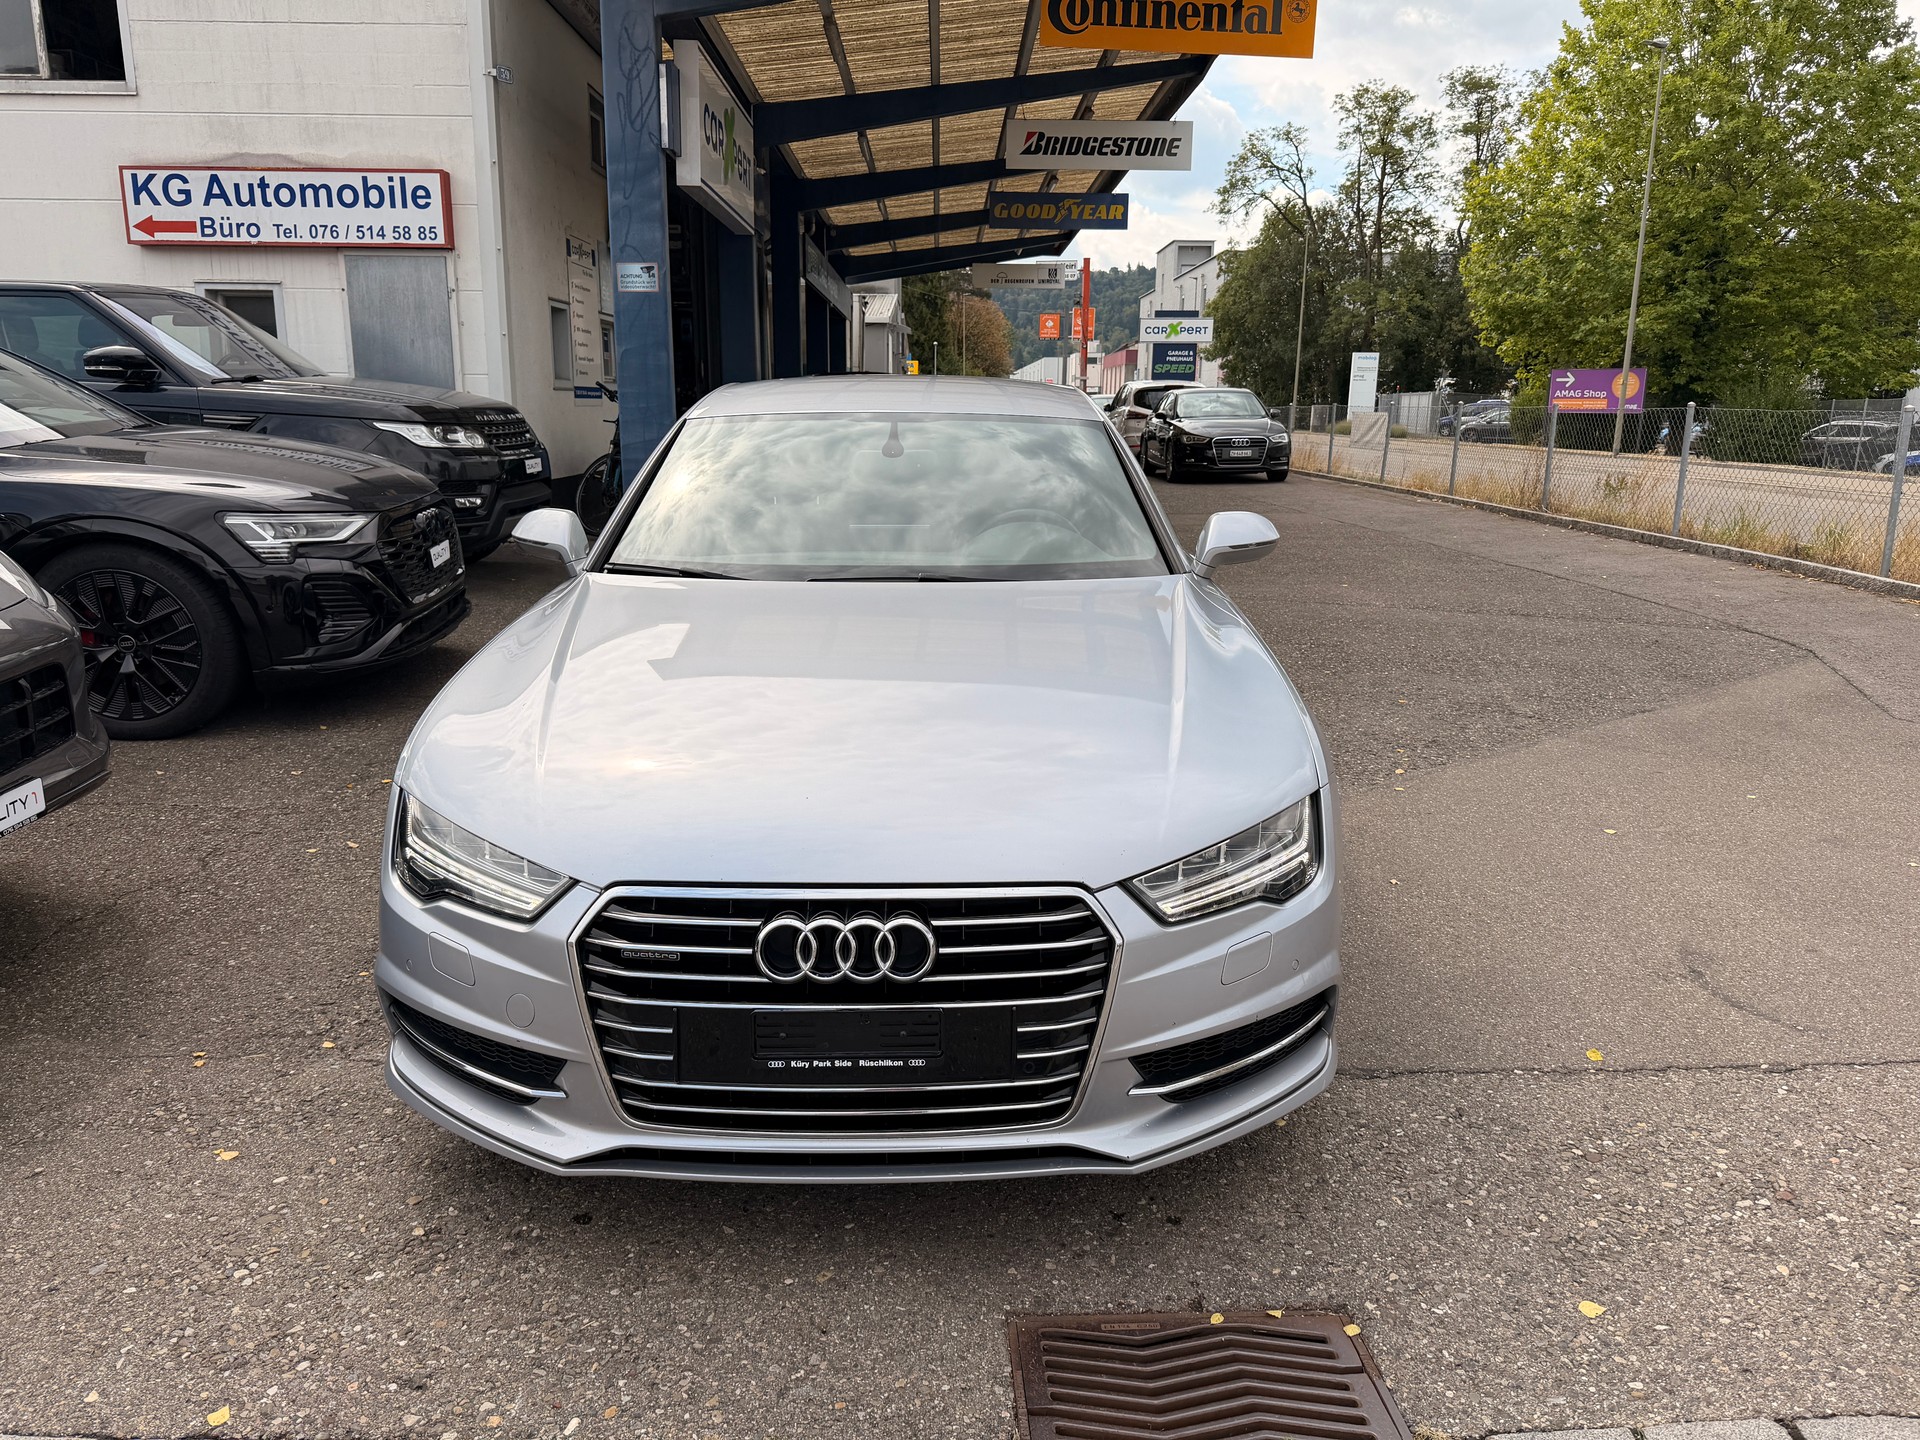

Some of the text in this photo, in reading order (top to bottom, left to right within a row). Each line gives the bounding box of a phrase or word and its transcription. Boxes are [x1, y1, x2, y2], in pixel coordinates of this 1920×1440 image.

[1047, 0, 1283, 35] Continental
[1020, 131, 1182, 157] BRIDGESTONE
[130, 172, 432, 210] KG Automobile
[199, 216, 261, 238] Büro
[273, 224, 303, 239] Tel.
[309, 224, 339, 239] 076
[356, 225, 386, 240] 514
[392, 226, 412, 241] 58
[418, 226, 438, 241] 85
[1154, 364, 1194, 373] SPEED
[1554, 389, 1607, 399] AMAG Shop
[623, 951, 678, 960] quattro
[791, 1059, 810, 1068] Küry
[859, 1059, 904, 1067] Rüschlikon
